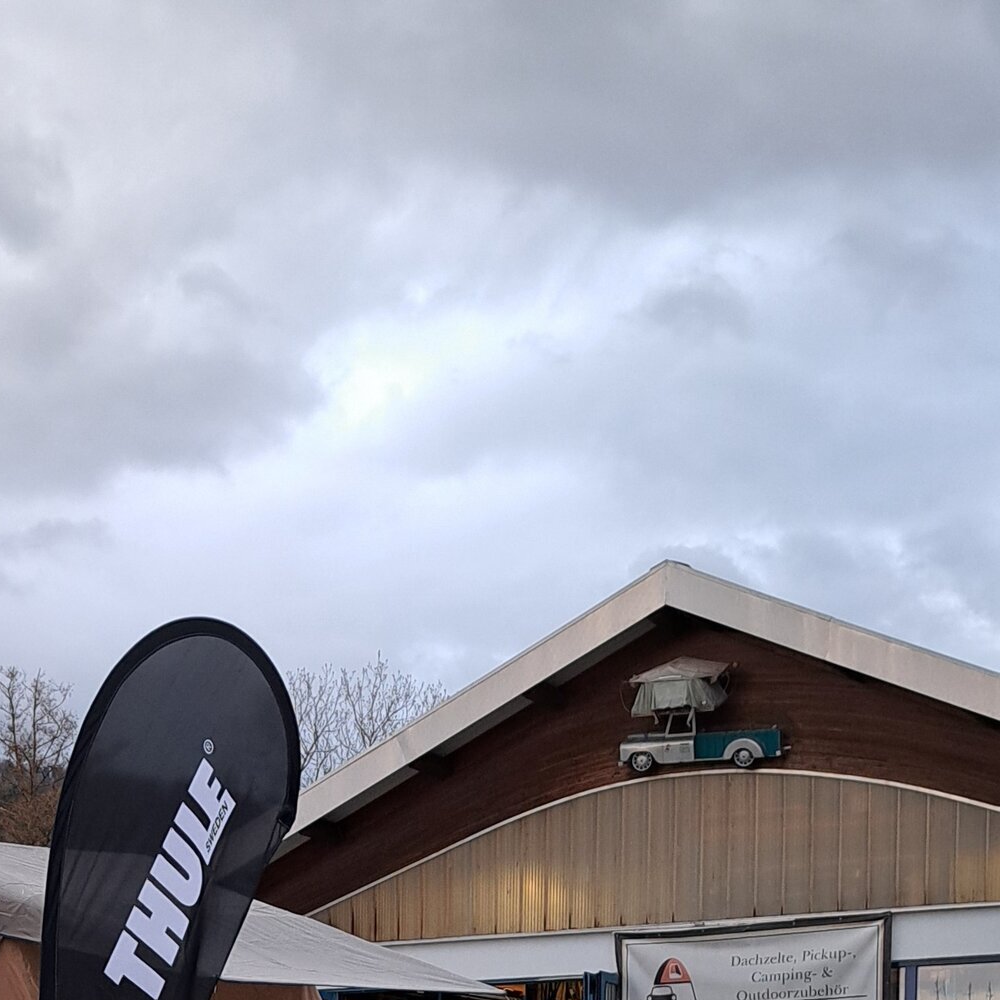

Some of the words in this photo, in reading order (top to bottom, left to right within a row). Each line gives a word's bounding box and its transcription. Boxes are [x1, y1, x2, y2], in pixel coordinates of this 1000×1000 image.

[204, 800, 230, 853] SWEDEN
[731, 951, 797, 967] Dachzelte,
[751, 969, 817, 985] Camping-
[821, 968, 833, 979] &
